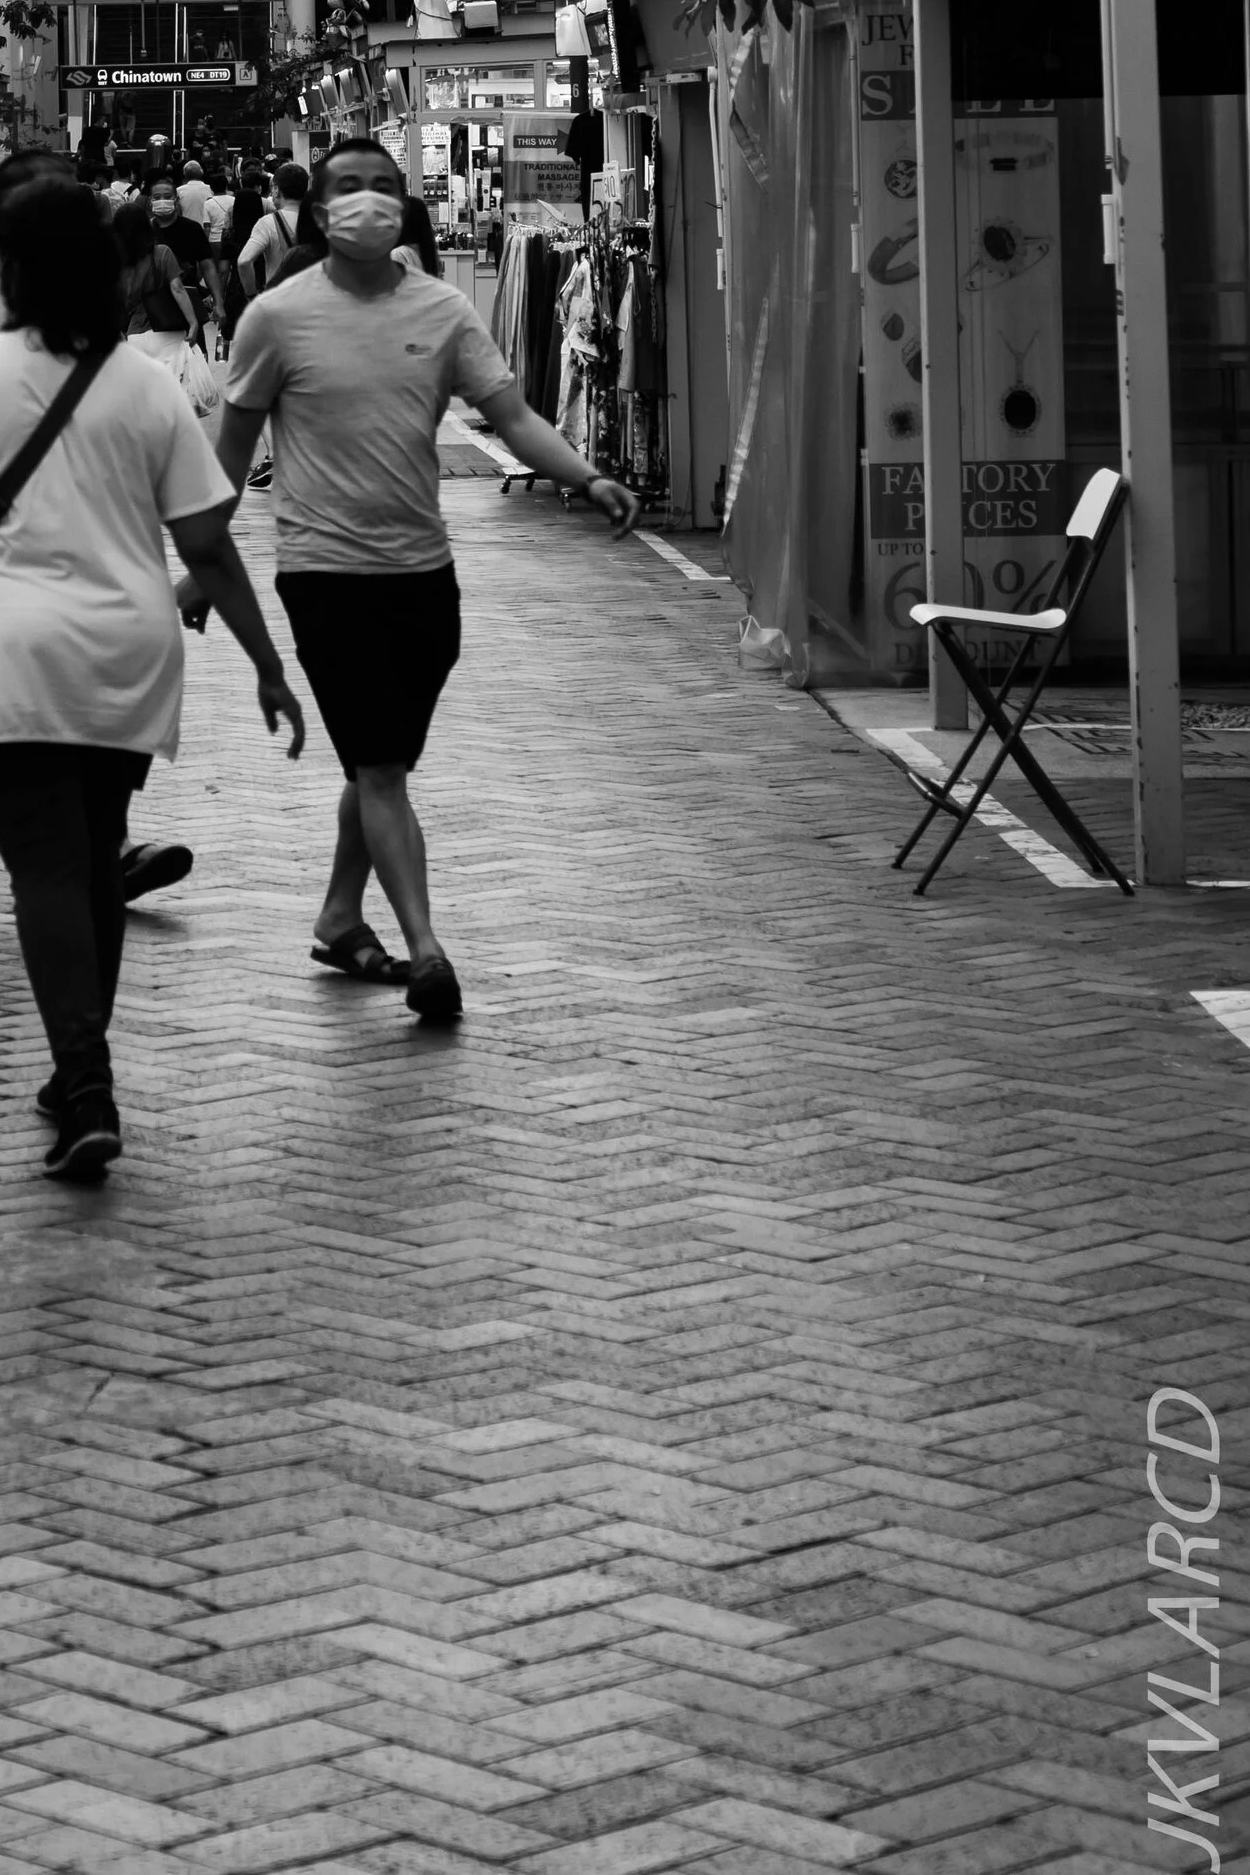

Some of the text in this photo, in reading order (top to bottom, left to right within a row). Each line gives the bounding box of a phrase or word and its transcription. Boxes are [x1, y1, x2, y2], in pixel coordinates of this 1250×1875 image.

[111, 70, 182, 84] Chinatown
[209, 71, 227, 79] DT19
[572, 83, 580, 98] 6
[517, 138, 557, 146] THIS WAY
[881, 464, 1057, 495] FATORY
[878, 543, 924, 556] UP TO
